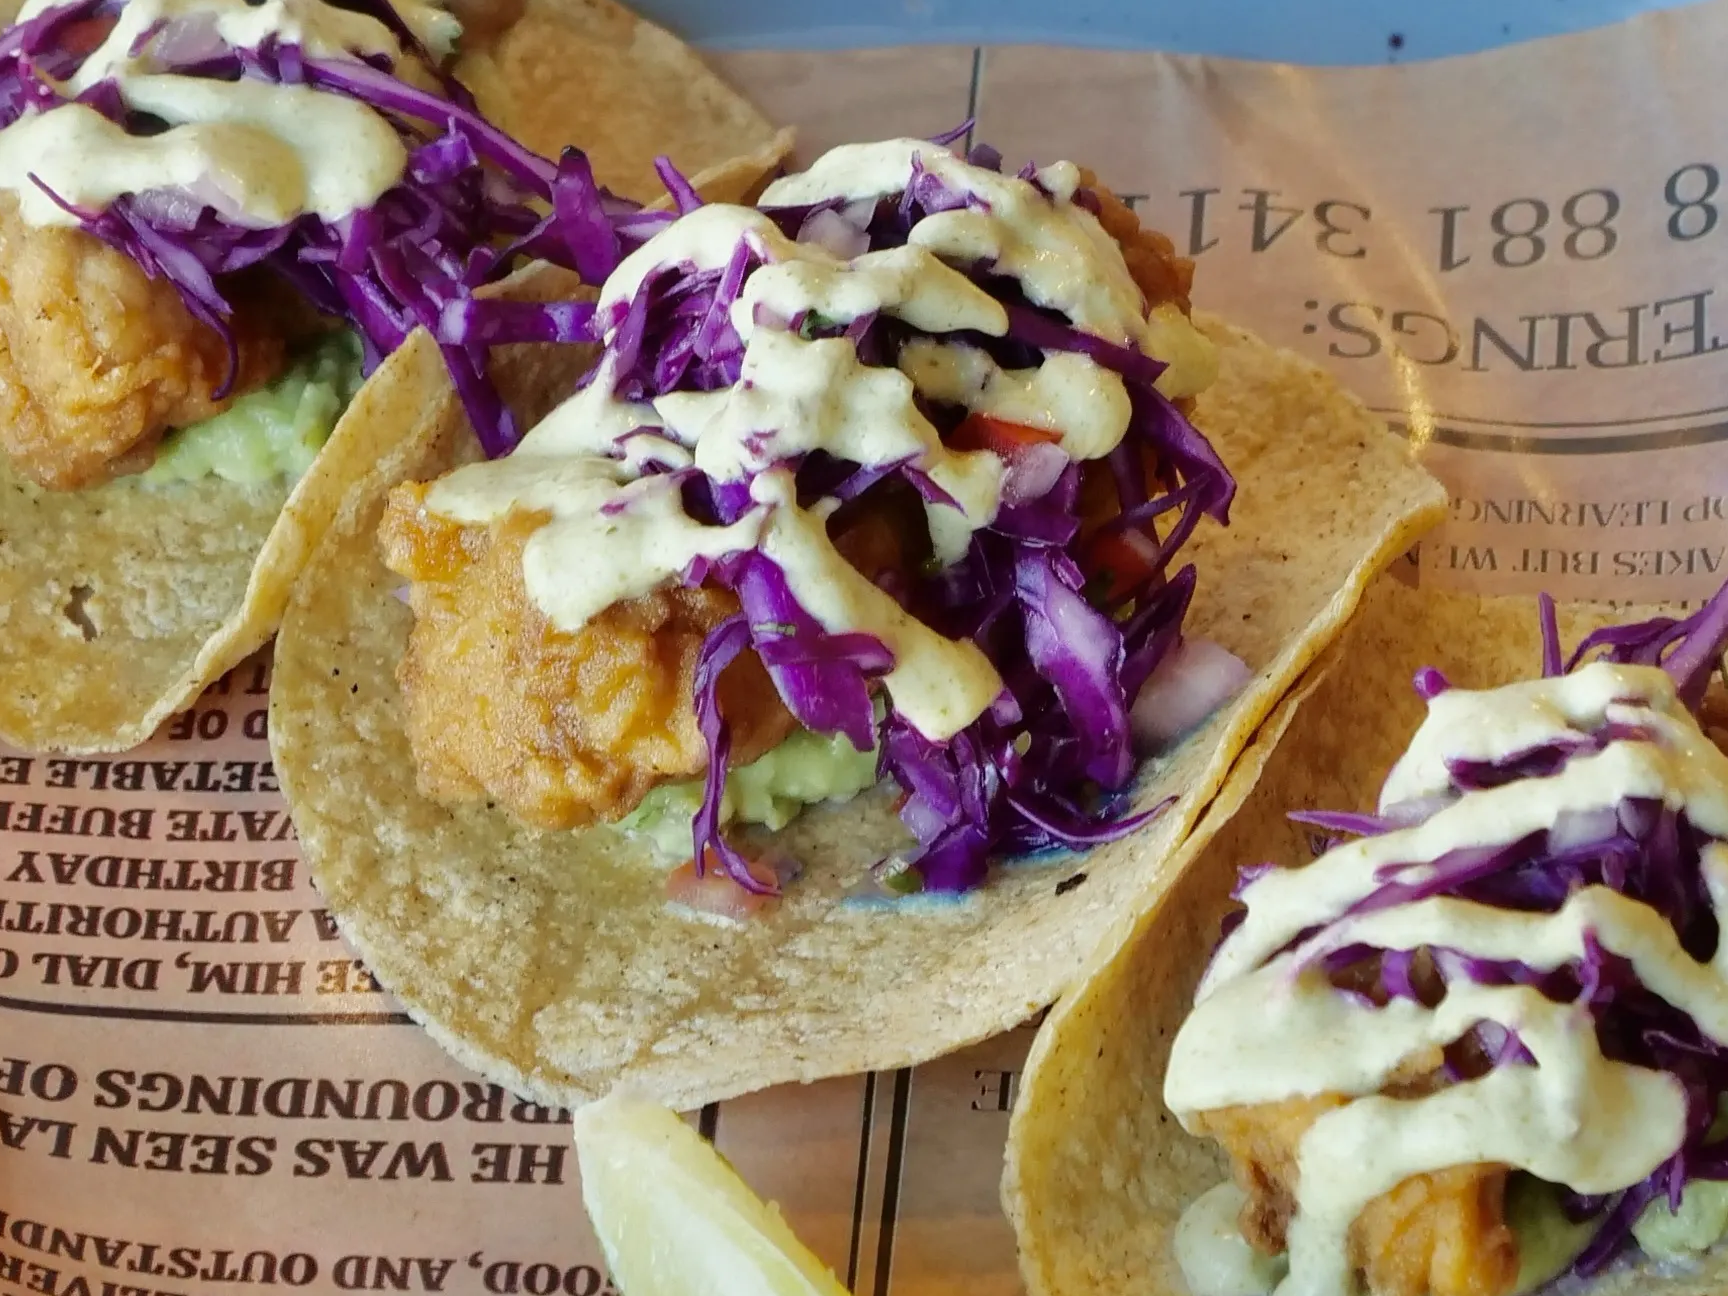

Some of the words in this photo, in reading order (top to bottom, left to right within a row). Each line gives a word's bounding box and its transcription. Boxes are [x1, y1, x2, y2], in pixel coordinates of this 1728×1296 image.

[1113, 187, 1372, 261] 341
[1425, 188, 1620, 273] 881
[1433, 544, 1497, 571] WE
[1511, 547, 1599, 576] BUT
[168, 708, 228, 742] OF
[44, 759, 280, 793] GETABLE
[165, 808, 298, 842] VATE
[3, 849, 298, 893] BIRTHDAY
[31, 952, 162, 992] DIAL
[174, 952, 306, 995] HIM,
[93, 1070, 573, 1125] RROUNDINGS
[88, 1126, 278, 1177] SEEN
[292, 1138, 456, 1183] WAS
[470, 1141, 570, 1186] HE
[332, 1254, 456, 1291] AND
